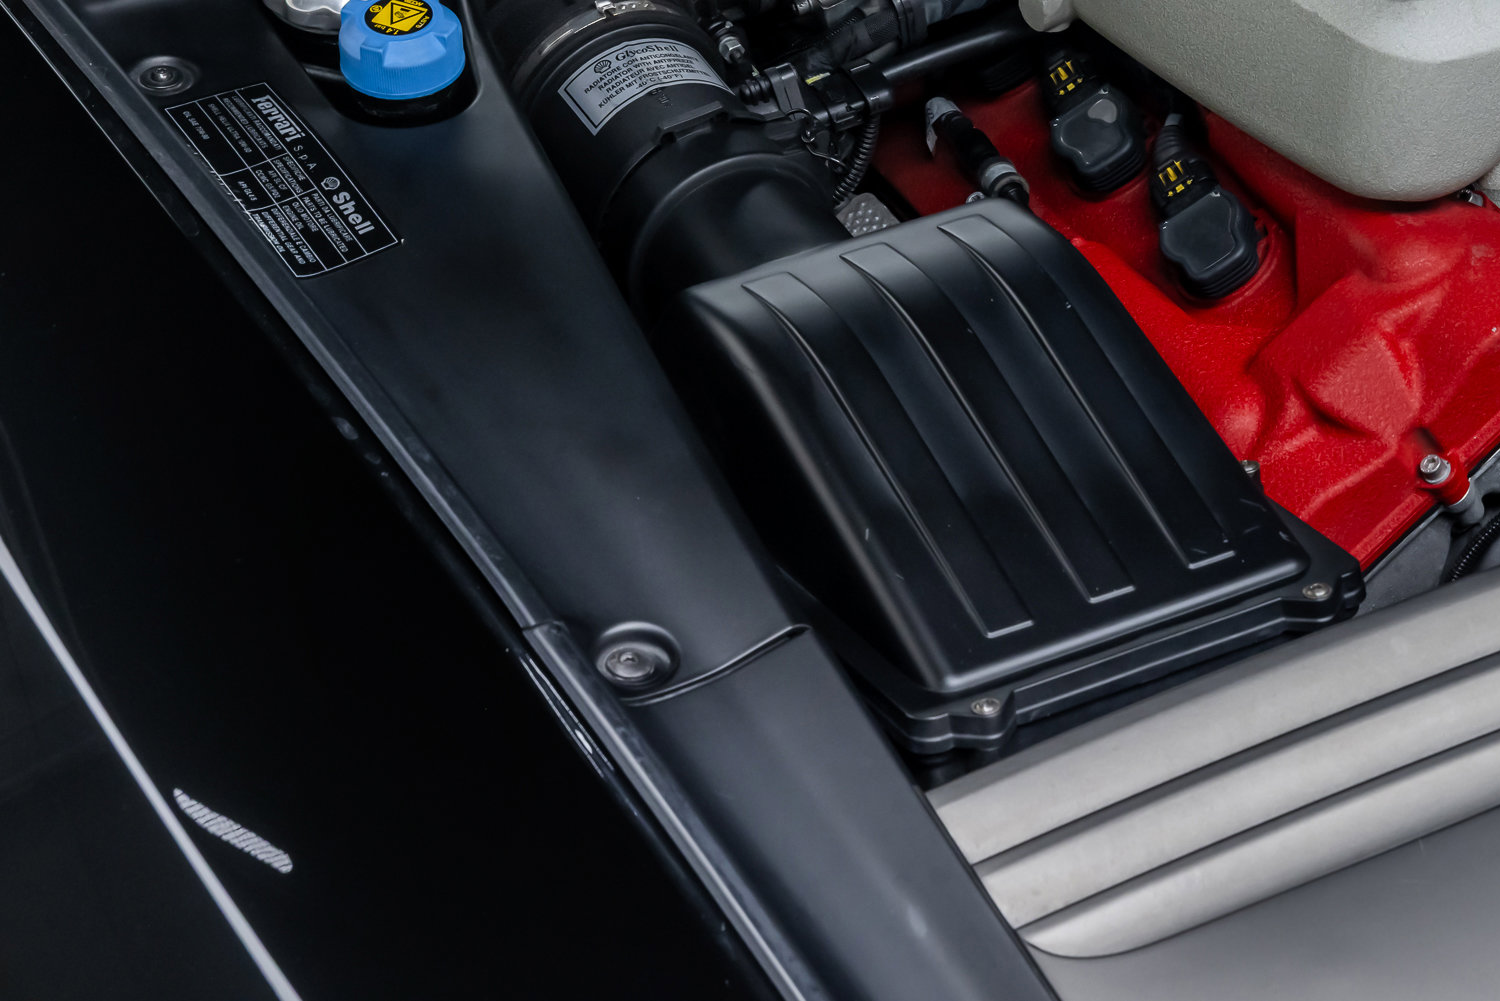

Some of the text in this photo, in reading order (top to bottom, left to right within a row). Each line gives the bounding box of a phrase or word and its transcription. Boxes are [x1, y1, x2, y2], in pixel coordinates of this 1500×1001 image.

[615, 44, 679, 61] GlycoShell
[584, 66, 622, 94] RADIATORE
[622, 58, 639, 69] CON
[598, 67, 633, 91] RADIATOR
[633, 60, 652, 69] WITH
[606, 69, 646, 93] RADIATEUR
[646, 64, 666, 72] AVEC
[625, 79, 638, 89] MIT
[249, 93, 306, 142] Ferrari
[271, 159, 304, 193] SPECIFICATIONS
[281, 156, 306, 181] SPECIFICHE
[281, 204, 299, 221] ENGINE
[290, 201, 318, 232] OLIO MOTORE
[300, 196, 317, 211] PARTS
[321, 224, 350, 253] LUBRICATED
[310, 192, 326, 206] PARTI
[324, 212, 353, 242] LUBRIFICARE
[332, 191, 375, 235] Shell
[260, 210, 306, 265] DIFFERENTIAL GEAR AND
[269, 207, 300, 241] DIFFERENZIALE
[298, 244, 317, 263] CAMBIO
